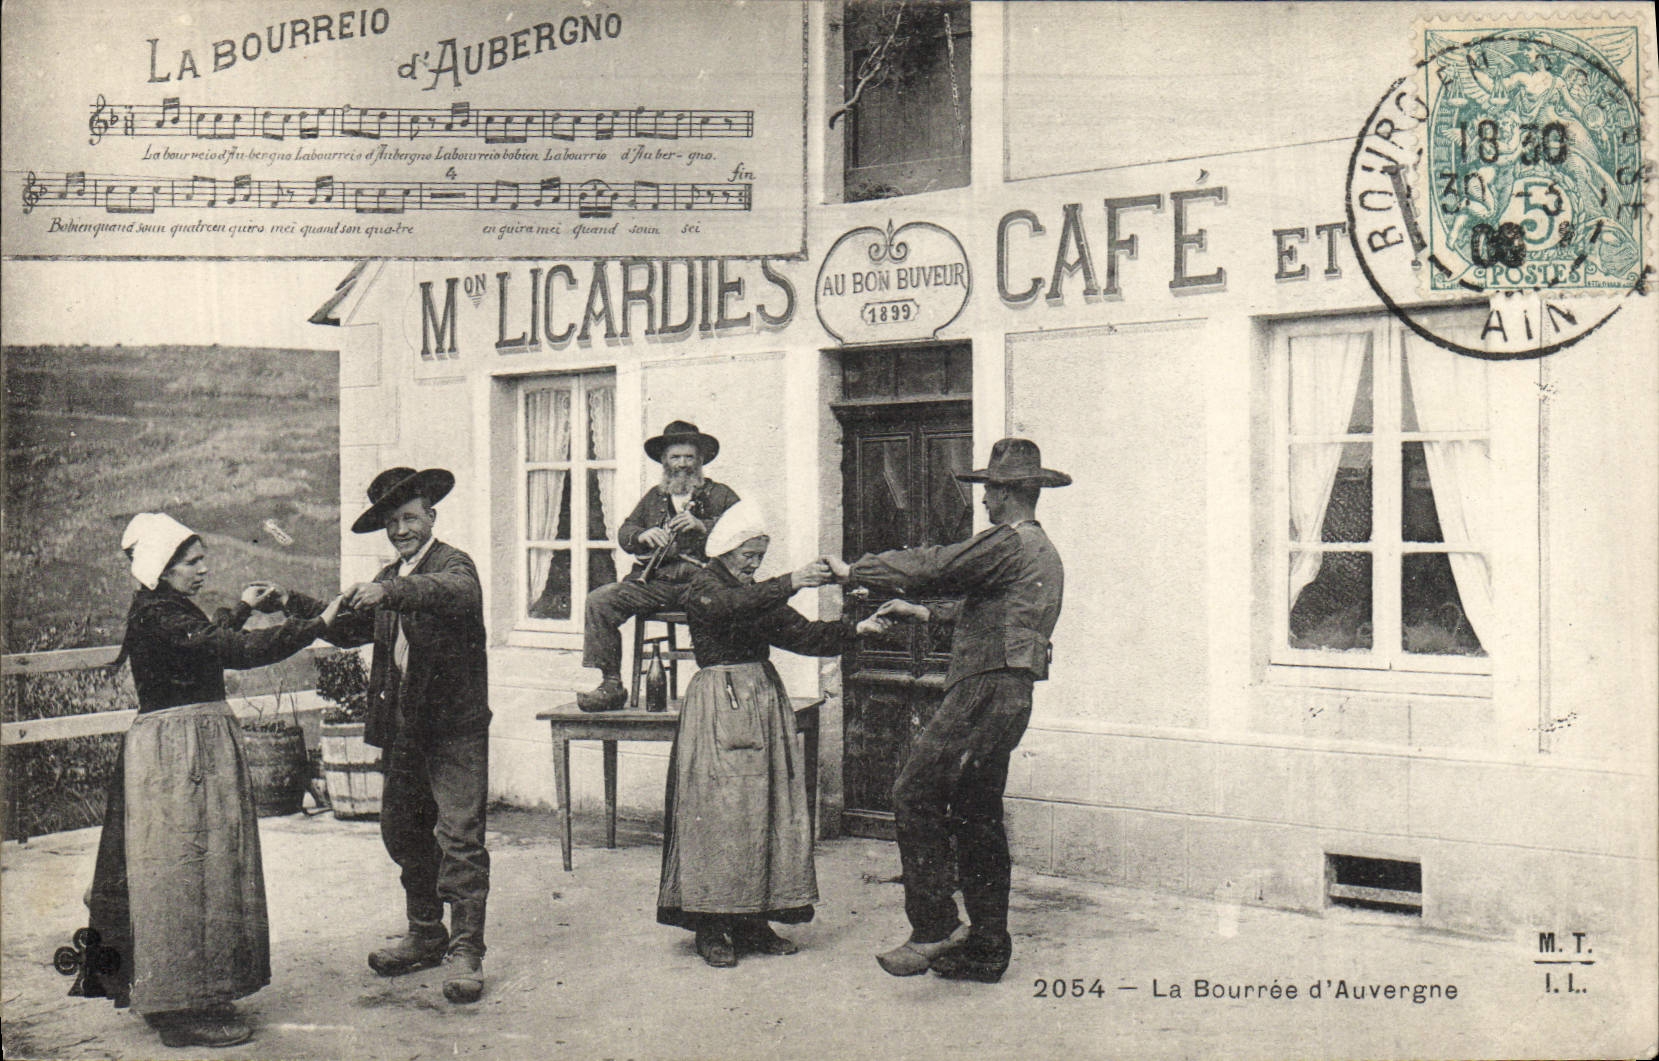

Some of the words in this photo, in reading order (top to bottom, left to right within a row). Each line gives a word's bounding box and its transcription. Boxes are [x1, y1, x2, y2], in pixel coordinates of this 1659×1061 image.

[996, 168, 1228, 310] CAFÉ
[1272, 221, 1347, 284] ET
[822, 273, 846, 296] AU
[852, 269, 890, 294] BON
[896, 262, 967, 290] BUVEUR
[1489, 263, 1581, 287] POSTES
[495, 258, 798, 355] LICARDIES
[868, 303, 911, 323] 1899
[1481, 300, 1578, 344] AIN
